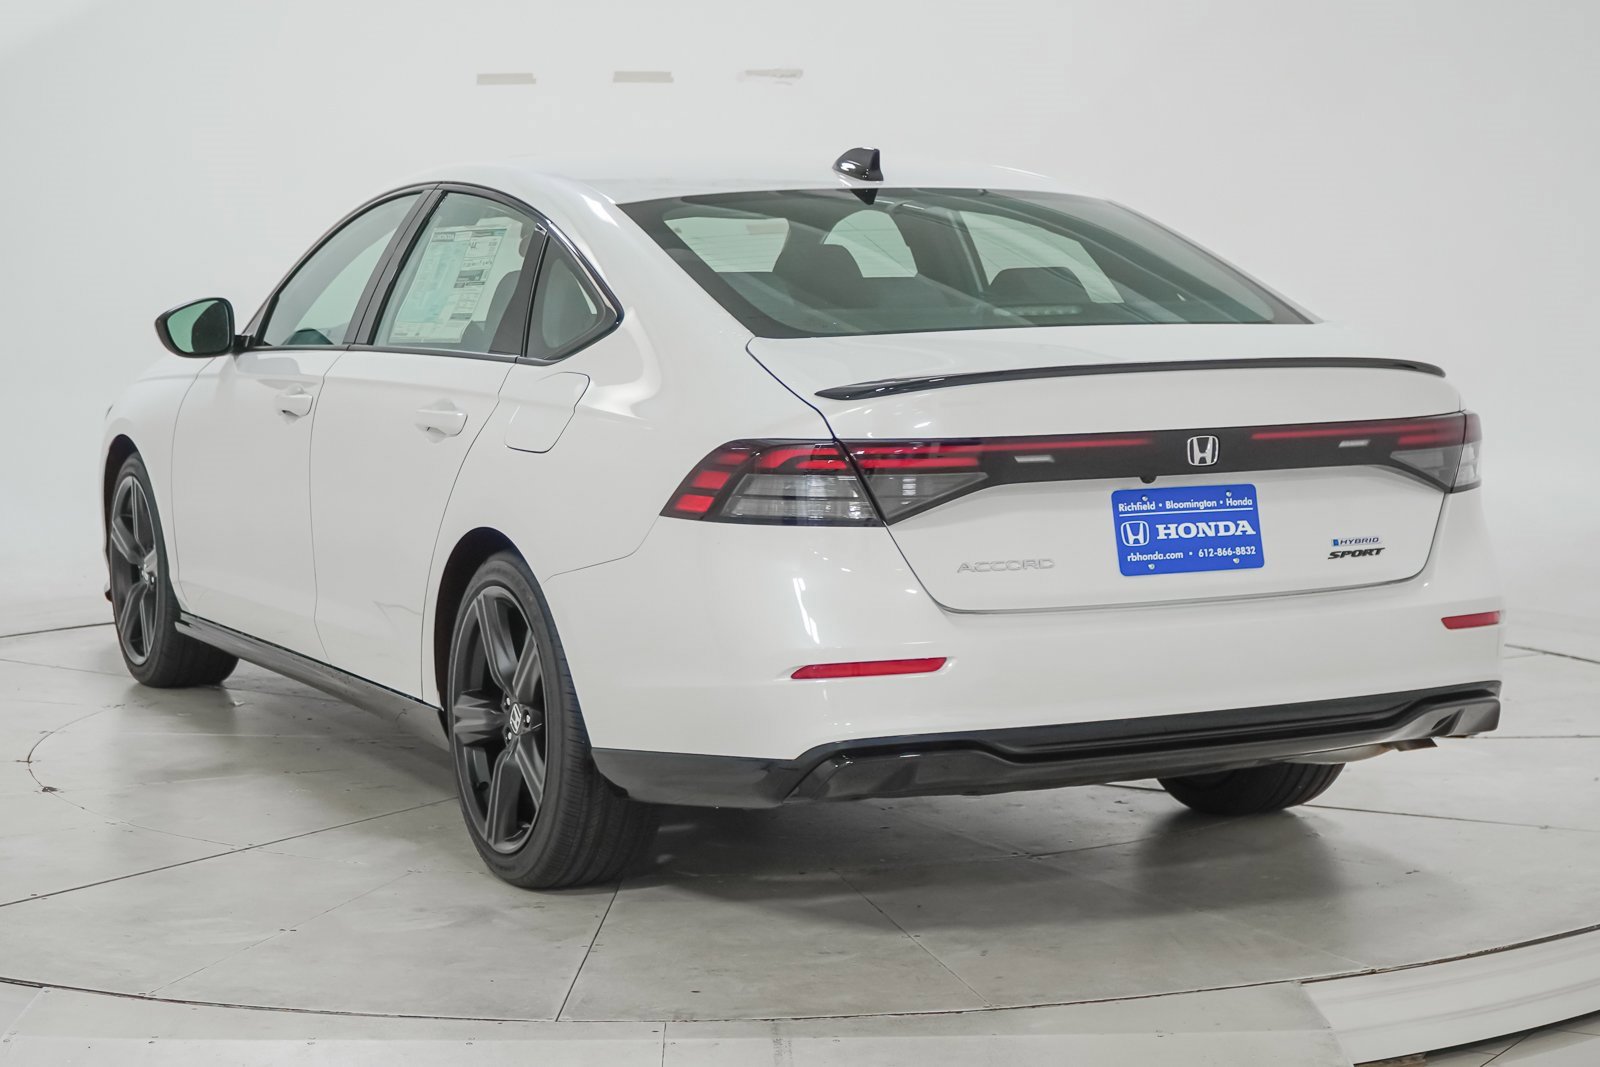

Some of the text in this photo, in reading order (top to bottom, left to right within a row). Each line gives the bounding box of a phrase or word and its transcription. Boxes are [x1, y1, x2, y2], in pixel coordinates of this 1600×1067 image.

[1118, 497, 1253, 512] Richfield Bloomington Honda
[1156, 520, 1256, 540] HONDA
[1340, 537, 1380, 545] HYBRID
[1127, 546, 1256, 562] rbhonda.com 612-866-8832
[1327, 547, 1386, 560] SPORT
[957, 559, 1055, 573] ACCORD
